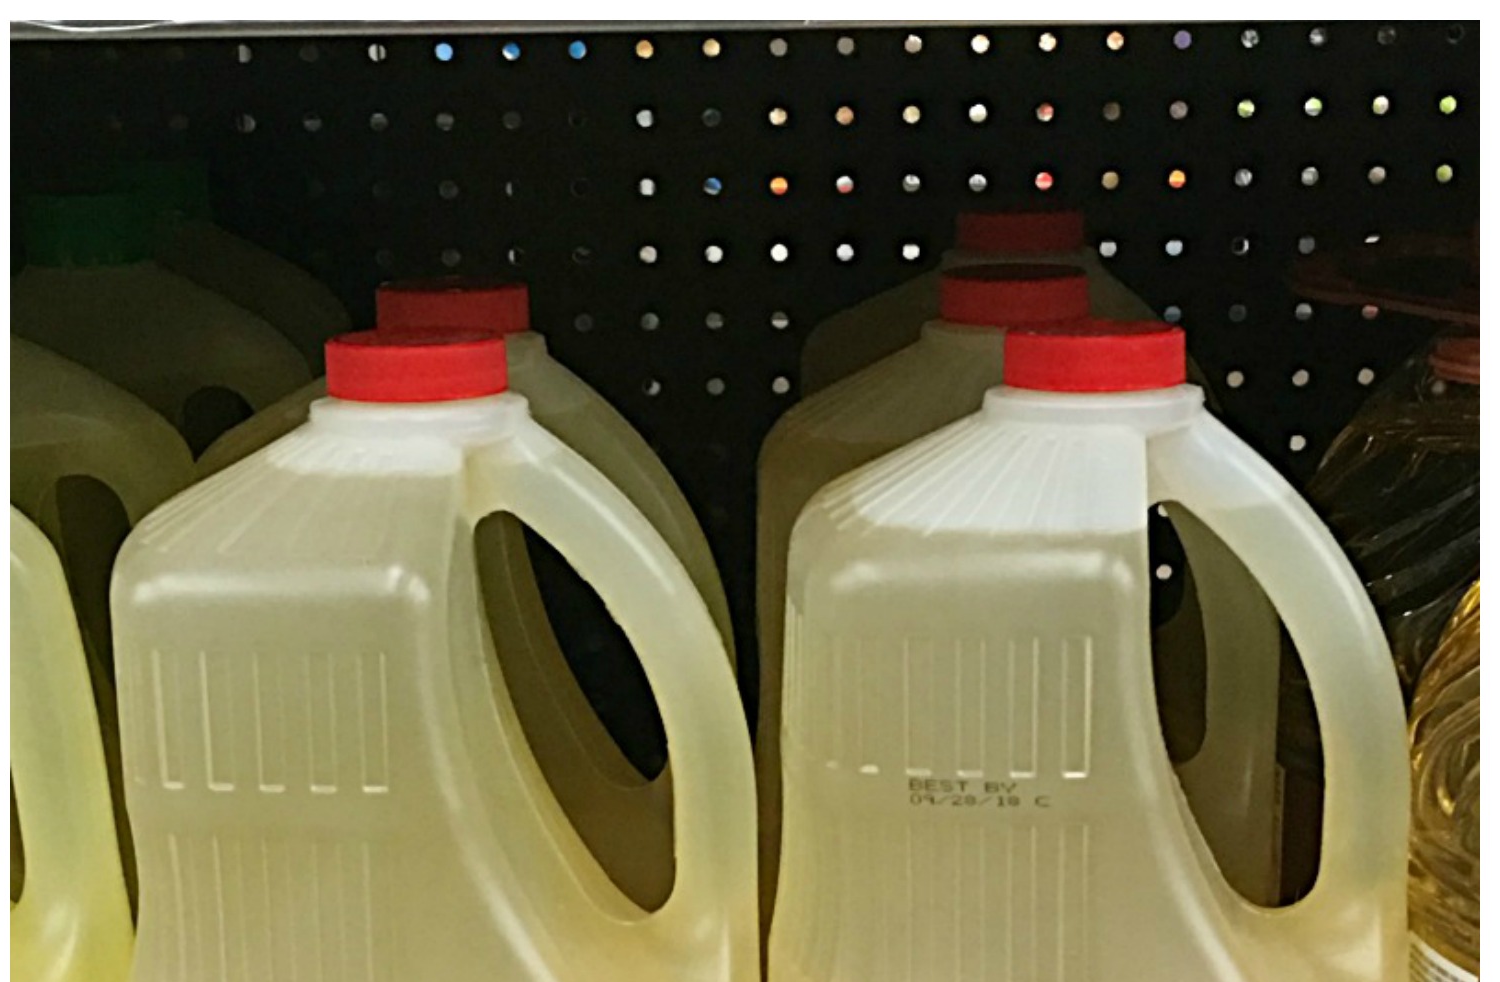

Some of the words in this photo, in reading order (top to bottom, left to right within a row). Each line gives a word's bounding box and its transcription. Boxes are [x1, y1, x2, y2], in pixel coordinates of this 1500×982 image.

[908, 779, 969, 794] BEST
[984, 781, 1017, 794] BY
[1035, 795, 1051, 808] C
